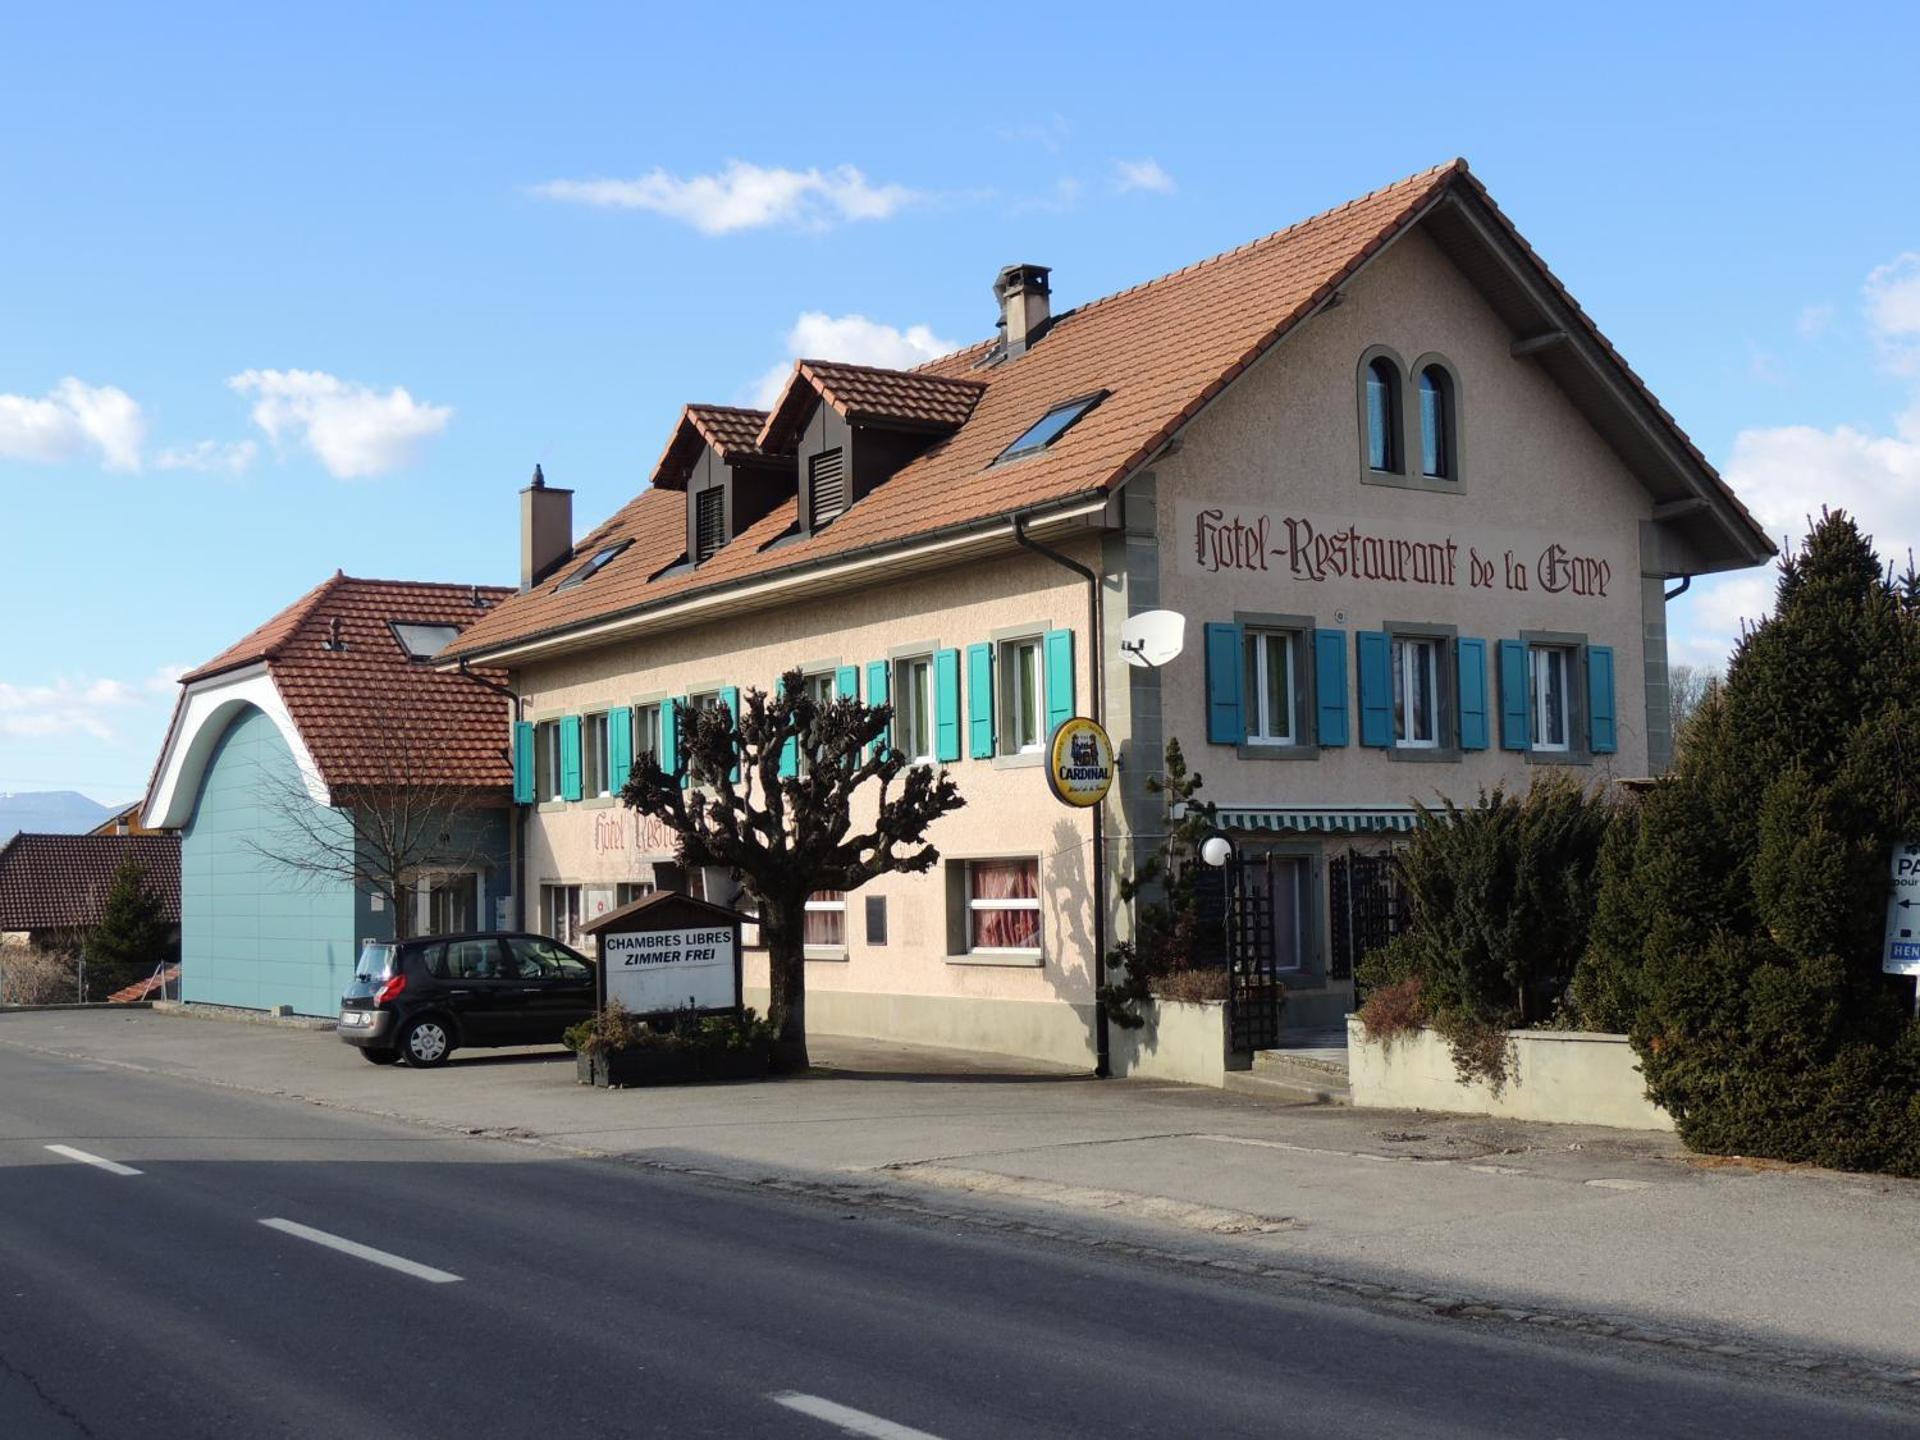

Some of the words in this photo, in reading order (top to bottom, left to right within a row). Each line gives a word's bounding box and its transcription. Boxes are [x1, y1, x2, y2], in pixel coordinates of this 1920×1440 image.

[1470, 547, 1495, 589] de
[1505, 550, 1530, 591] la
[1537, 544, 1611, 598] Gare
[1059, 766, 1110, 780] CARDINAL
[1898, 859, 1920, 876] PA
[606, 934, 682, 950] CHAMBRES
[685, 931, 731, 945] LIBRES
[624, 950, 681, 966] ZIMMER
[685, 949, 715, 962] FREI
[1893, 945, 1920, 957] HEN
